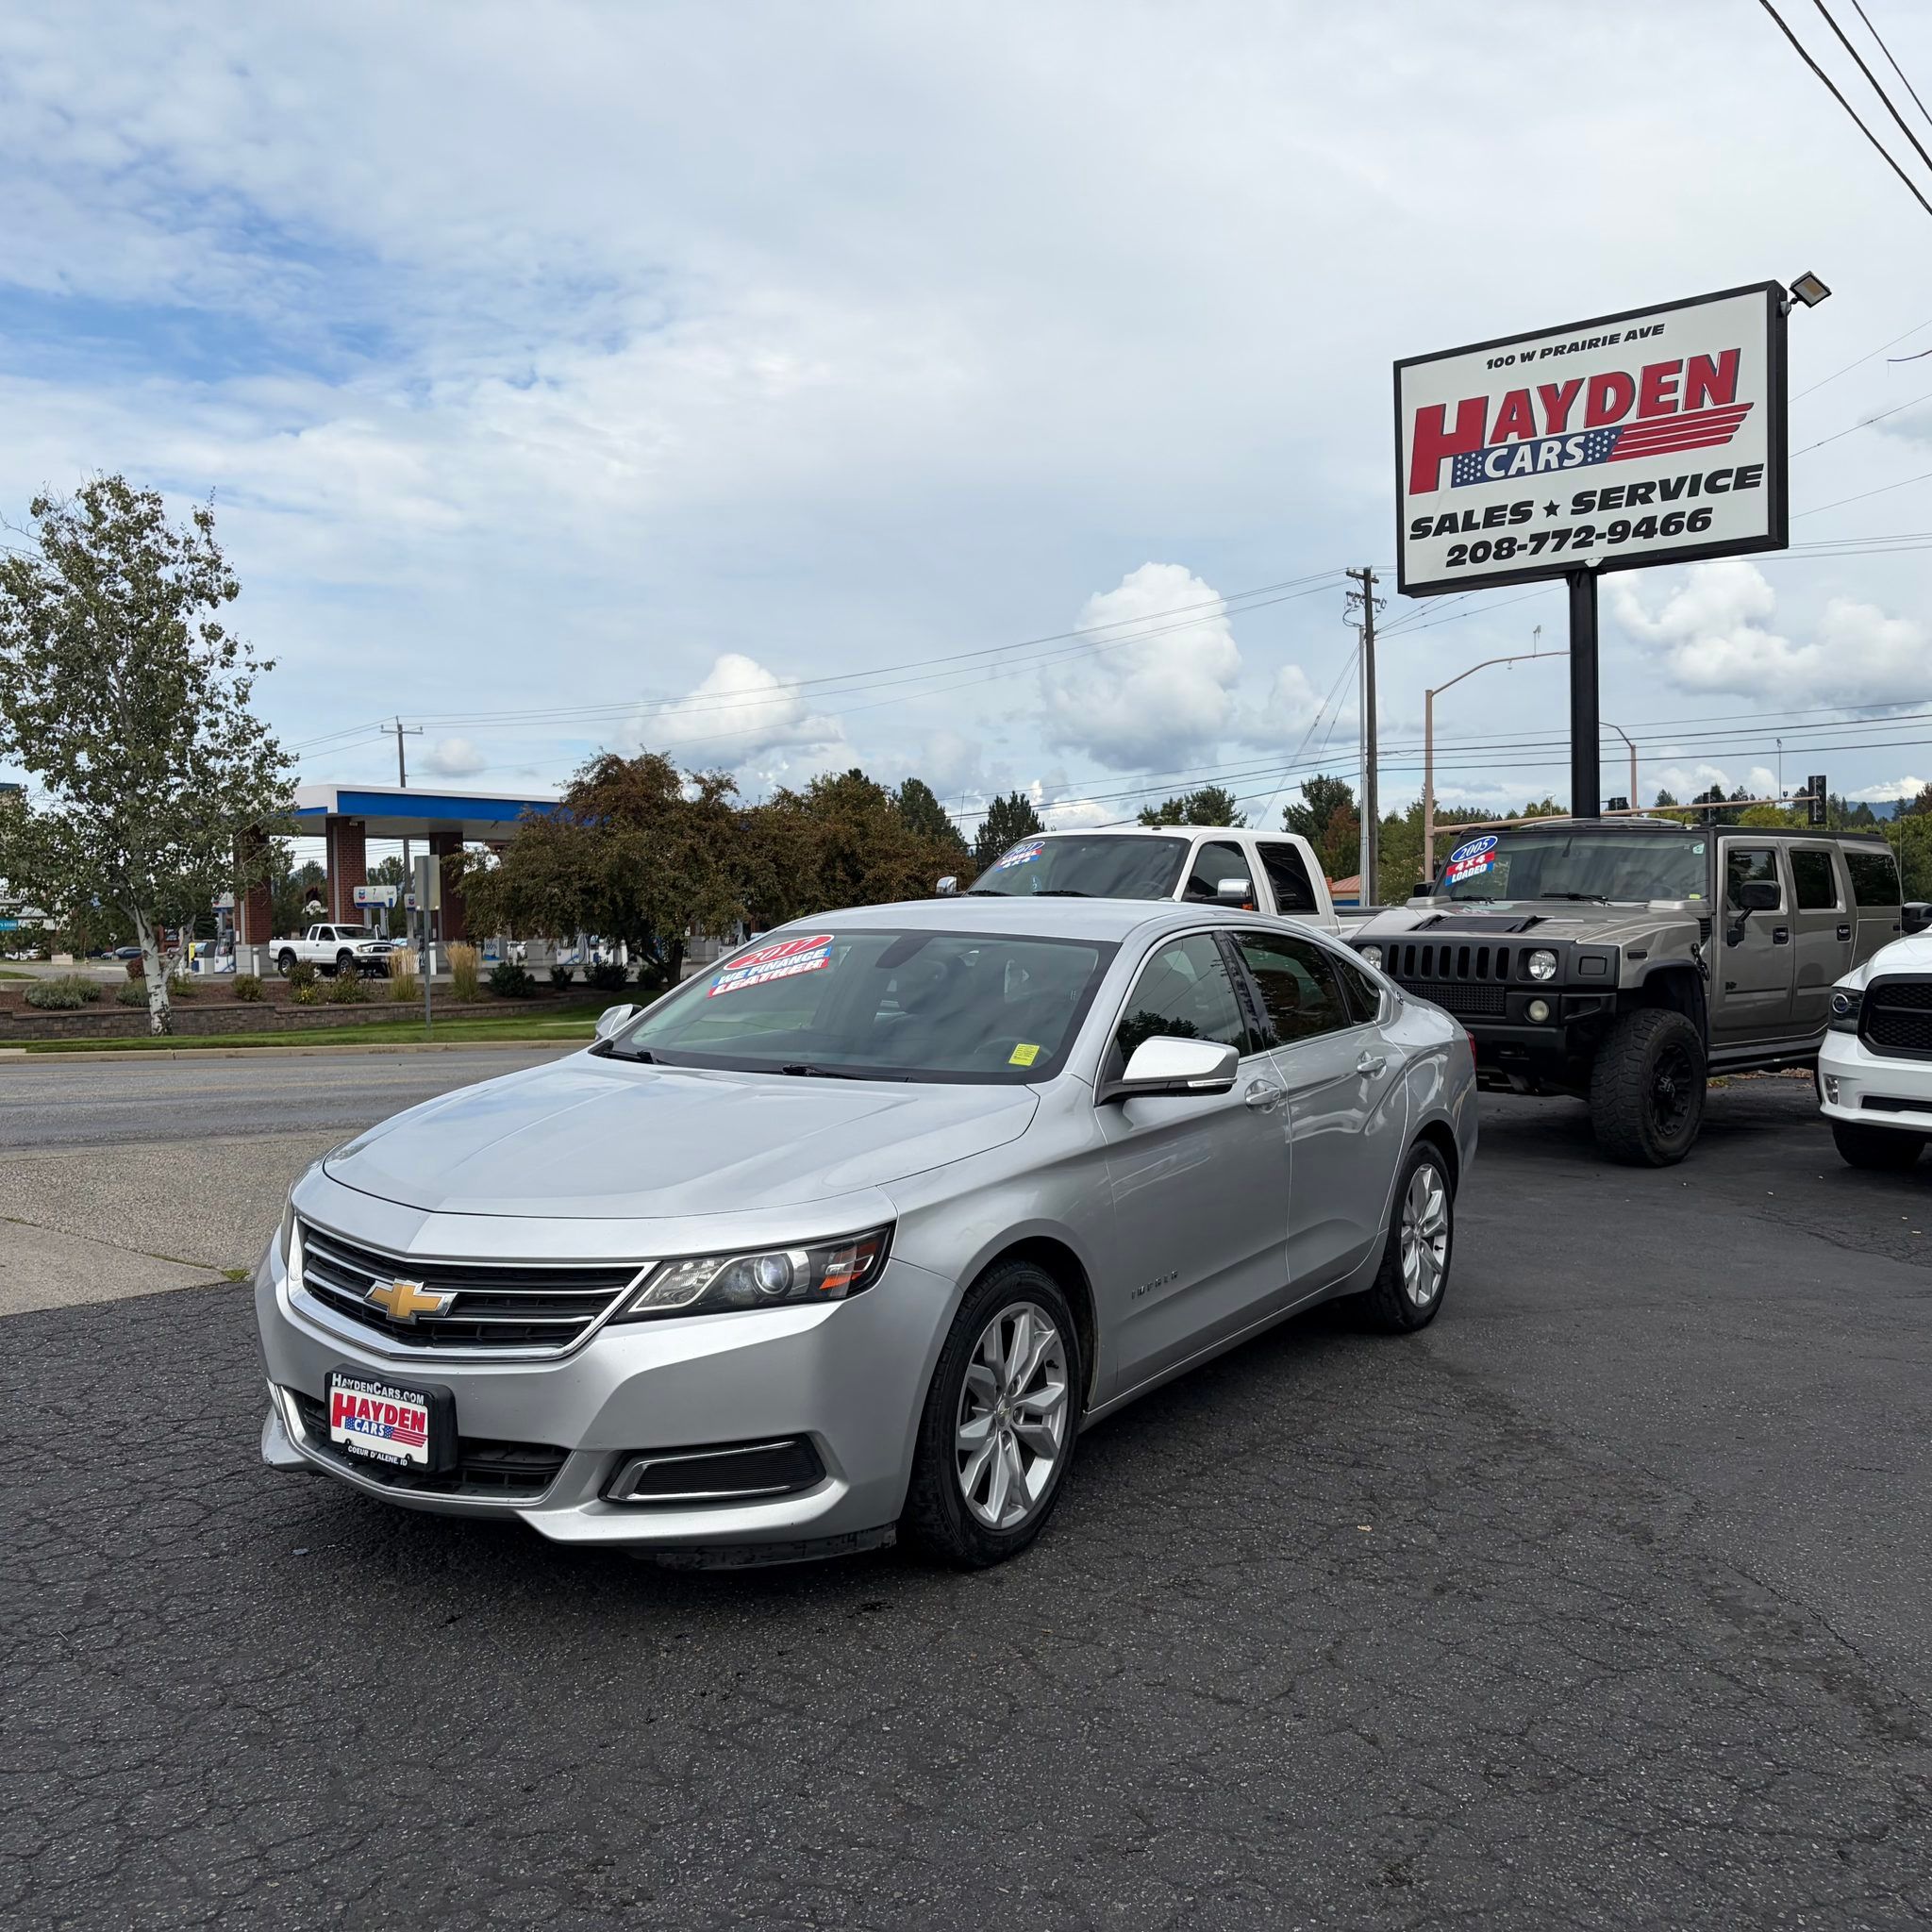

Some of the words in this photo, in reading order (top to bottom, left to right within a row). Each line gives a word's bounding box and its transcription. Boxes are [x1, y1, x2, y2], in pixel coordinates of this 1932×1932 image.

[1487, 355, 1515, 370] 100
[1519, 350, 1537, 362] W
[1540, 333, 1620, 359] PRAIRIE
[1624, 324, 1665, 343] AVE
[1409, 347, 1741, 495] HAYDEN
[1484, 434, 1587, 479] CARS
[1409, 500, 1535, 541] SALES
[1570, 463, 1764, 515] SERVICE
[1446, 507, 1714, 567] 208-772-9466
[1457, 838, 1491, 860] 2005
[1451, 863, 1488, 883] LOADED
[719, 969, 748, 983] WE
[750, 948, 827, 975] FINANCE
[740, 938, 815, 968] 2017
[712, 958, 826, 996] LEATHER
[332, 1392, 426, 1433] HAYDEN
[354, 1419, 385, 1437] CARS
[348, 1445, 369, 1457] COEUR
